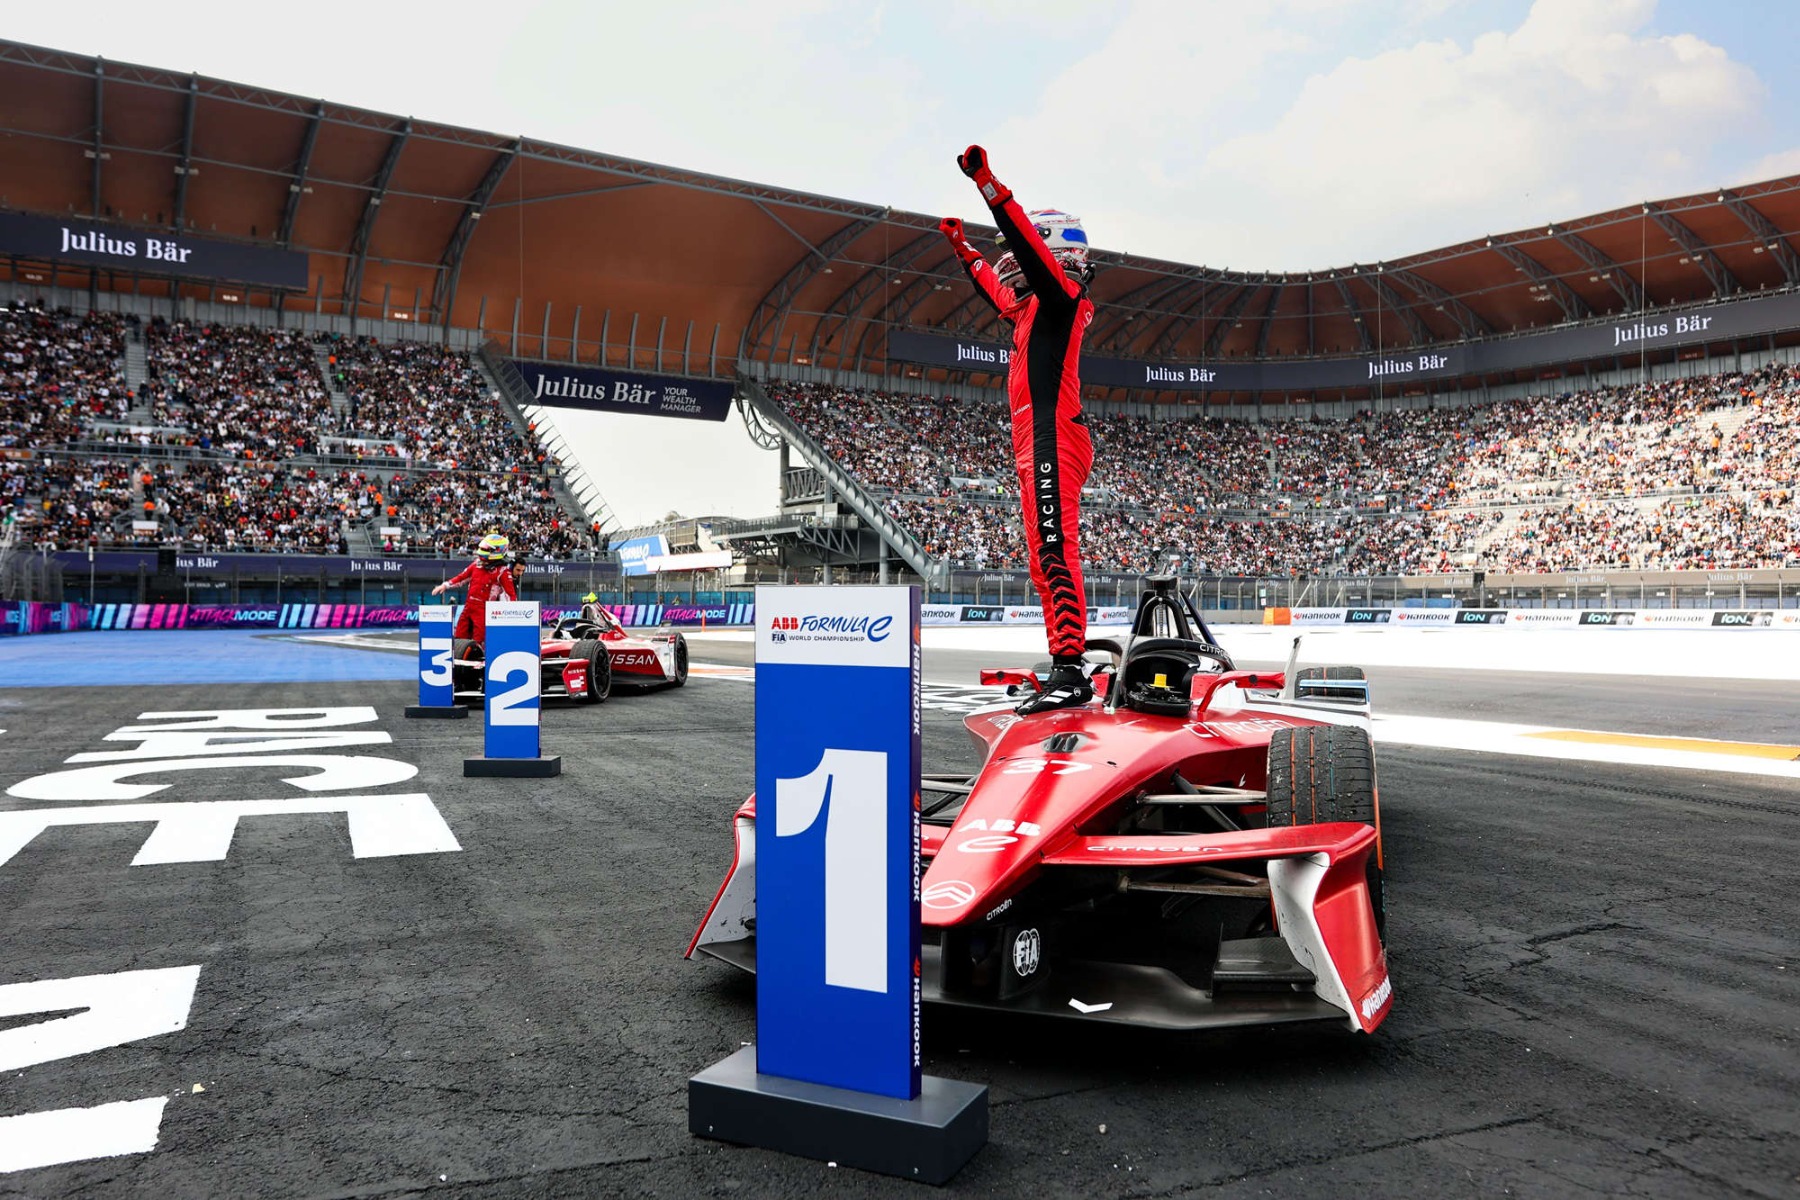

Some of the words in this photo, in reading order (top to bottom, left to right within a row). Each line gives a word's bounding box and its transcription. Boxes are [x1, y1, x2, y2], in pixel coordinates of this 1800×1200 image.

[60, 227, 137, 257] Julius
[145, 238, 192, 263] Bär
[1614, 321, 1668, 346] Julius
[1675, 314, 1712, 335] Bär
[957, 343, 995, 363] Julius
[1145, 366, 1185, 383] Julius
[1189, 367, 1216, 383] Bär
[1368, 360, 1414, 379] Julius
[1418, 354, 1448, 371] Bär
[535, 374, 606, 400] Julius
[612, 381, 657, 404] Bär
[664, 386, 688, 397] YOUR
[660, 403, 702, 413] MANAGER
[662, 395, 697, 405] WEALTH
[1040, 462, 1058, 543] RACING
[197, 557, 218, 567] Bär
[351, 561, 381, 572] Juius
[383, 561, 402, 571] Bär
[525, 564, 545, 574] ulius
[547, 565, 564, 574] Bär
[771, 617, 799, 630] ABB
[800, 615, 870, 633] FORMULA
[421, 638, 452, 687] 3
[488, 651, 539, 726] 2
[1002, 759, 1093, 775] 37
[958, 819, 1041, 836] ABB
[776, 748, 887, 993] 1
